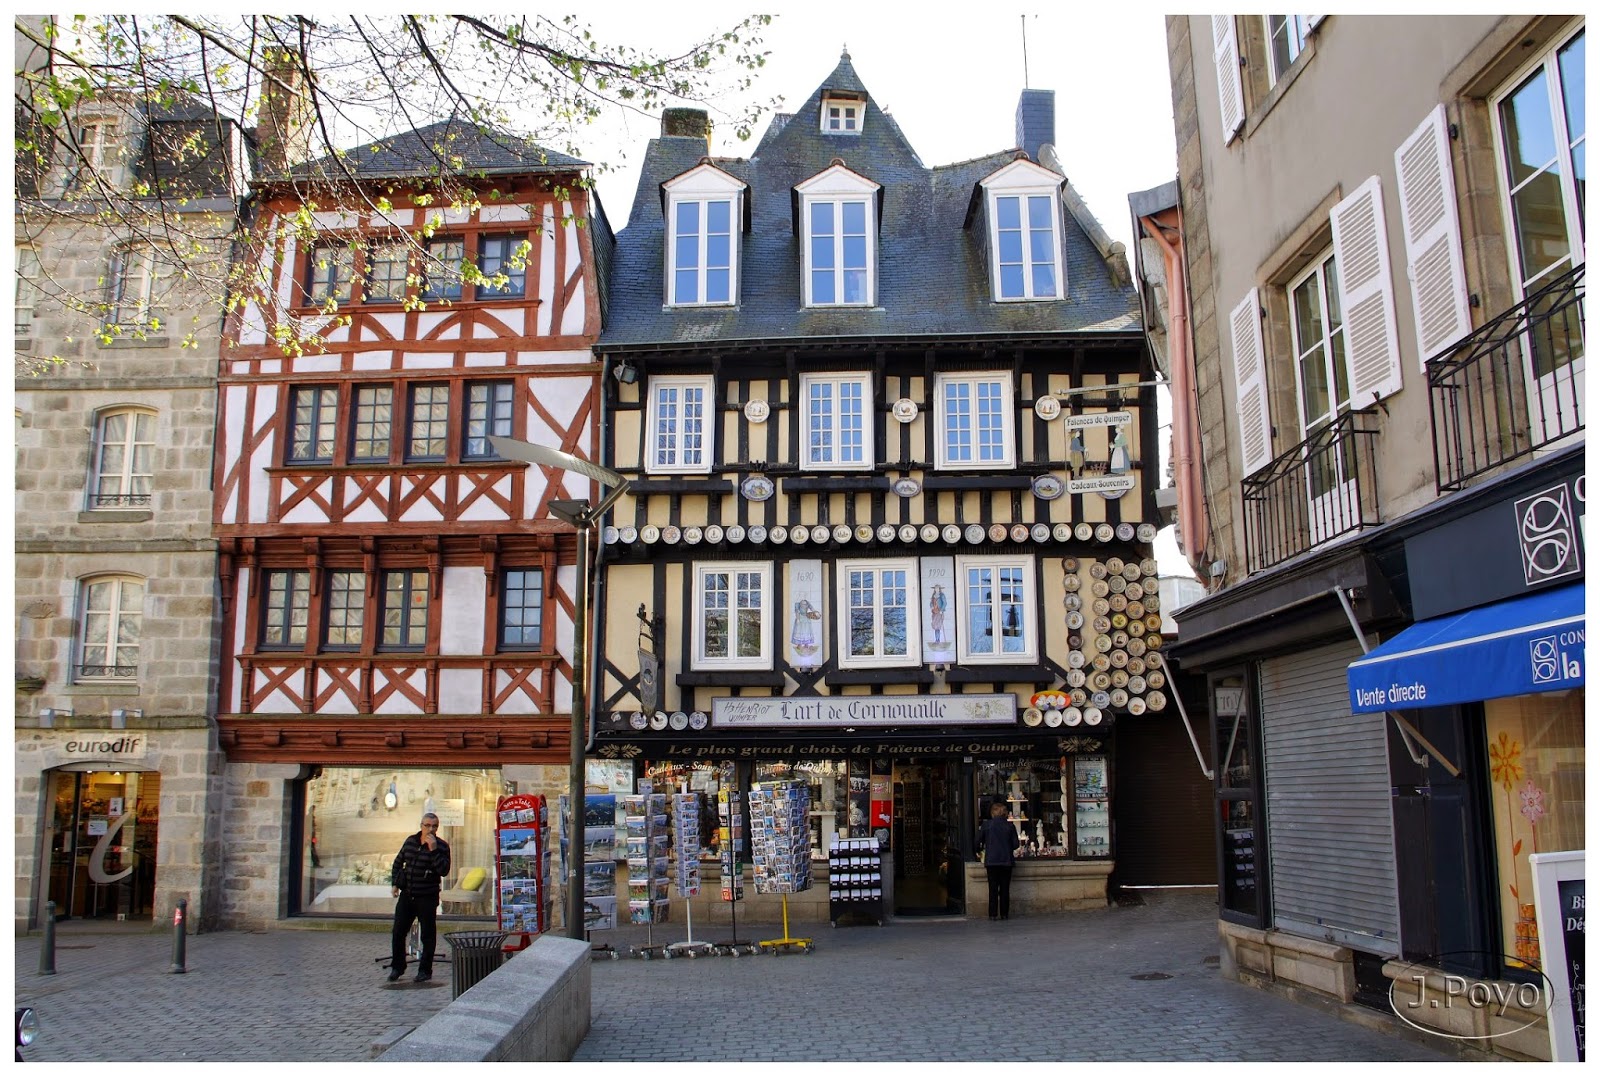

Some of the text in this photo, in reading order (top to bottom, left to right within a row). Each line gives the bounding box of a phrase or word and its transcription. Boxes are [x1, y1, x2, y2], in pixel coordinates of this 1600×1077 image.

[1095, 416, 1102, 424] de
[1103, 415, 1129, 424] Quimper
[797, 571, 815, 581] 1690
[928, 569, 946, 577] 1990
[1561, 652, 1581, 679] la
[1356, 681, 1426, 707] Vente directe
[828, 705, 842, 720] de
[848, 699, 947, 720] Cornouaille
[65, 738, 140, 753] eurodif
[668, 745, 692, 754] Le
[696, 745, 736, 757] plus
[740, 745, 795, 757] grand
[799, 745, 847, 754] choix
[851, 745, 871, 754] de
[945, 743, 963, 753] de
[967, 743, 1035, 754] Quimper
